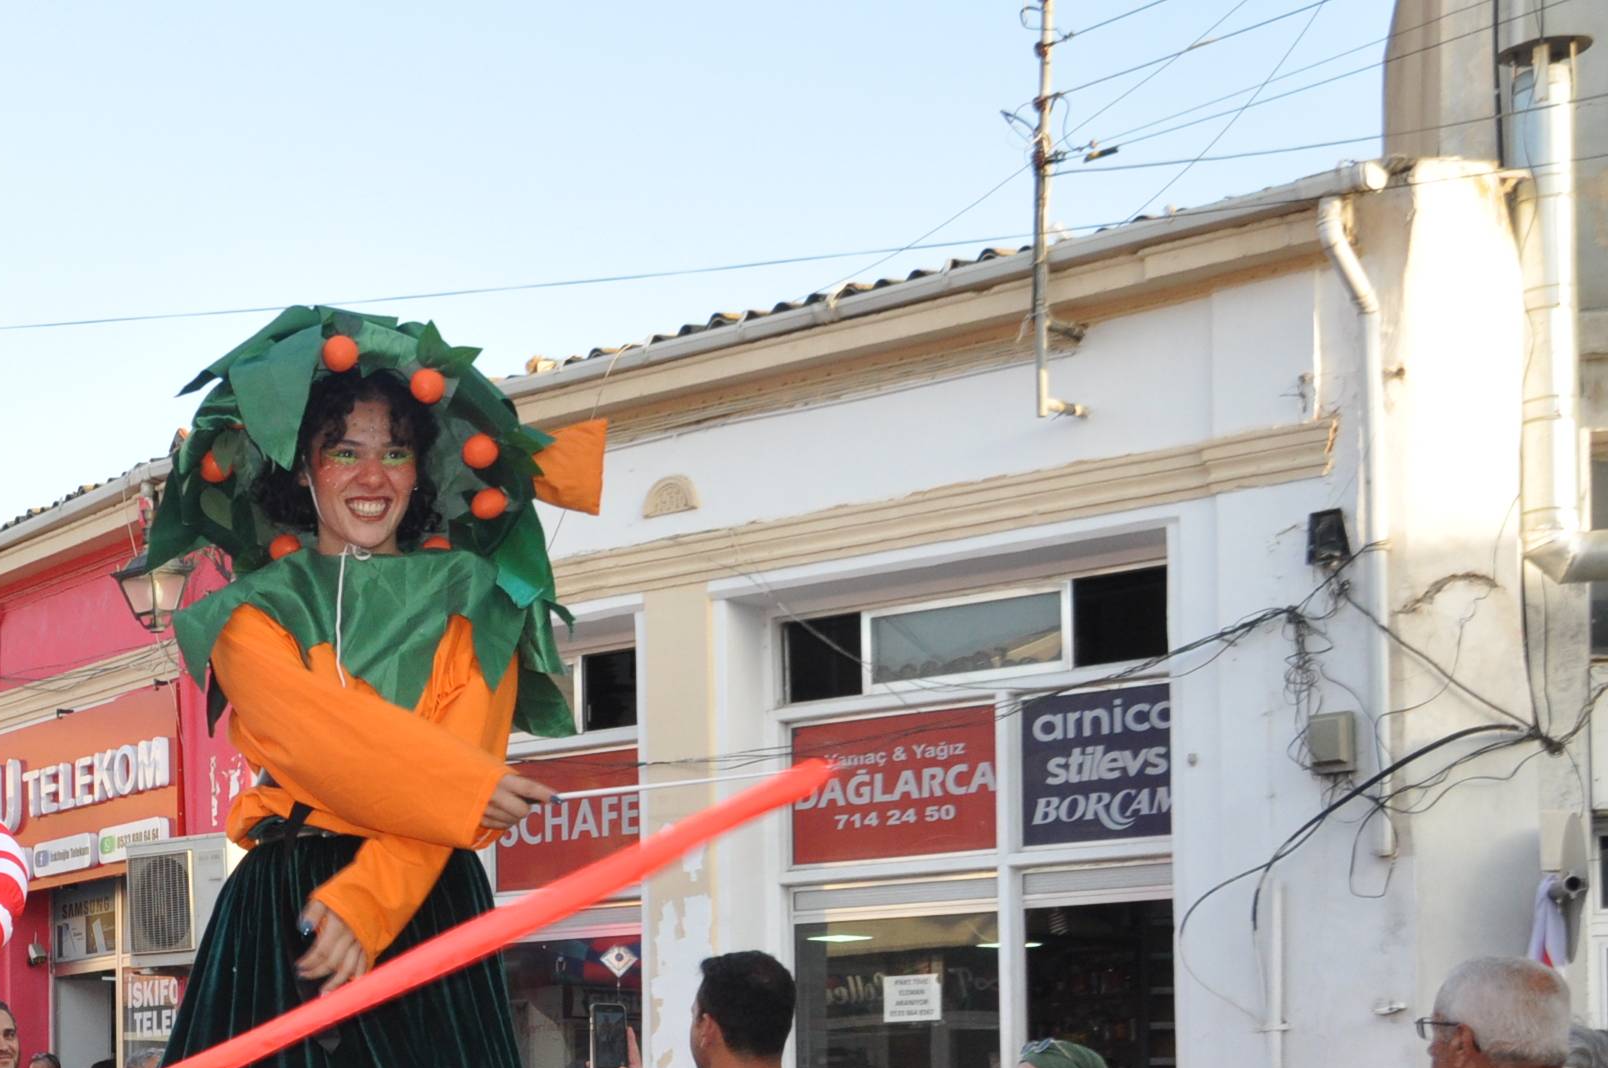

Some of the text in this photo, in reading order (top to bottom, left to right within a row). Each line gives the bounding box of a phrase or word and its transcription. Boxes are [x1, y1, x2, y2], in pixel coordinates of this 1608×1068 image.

[893, 746, 907, 761] &
[912, 741, 966, 760] Yağız
[1045, 745, 1169, 785] stilevs
[22, 736, 169, 817] TELEKOM
[834, 804, 955, 830] 714 24 50
[62, 897, 110, 919] SAMSUNG
[134, 1009, 177, 1040] TELE
